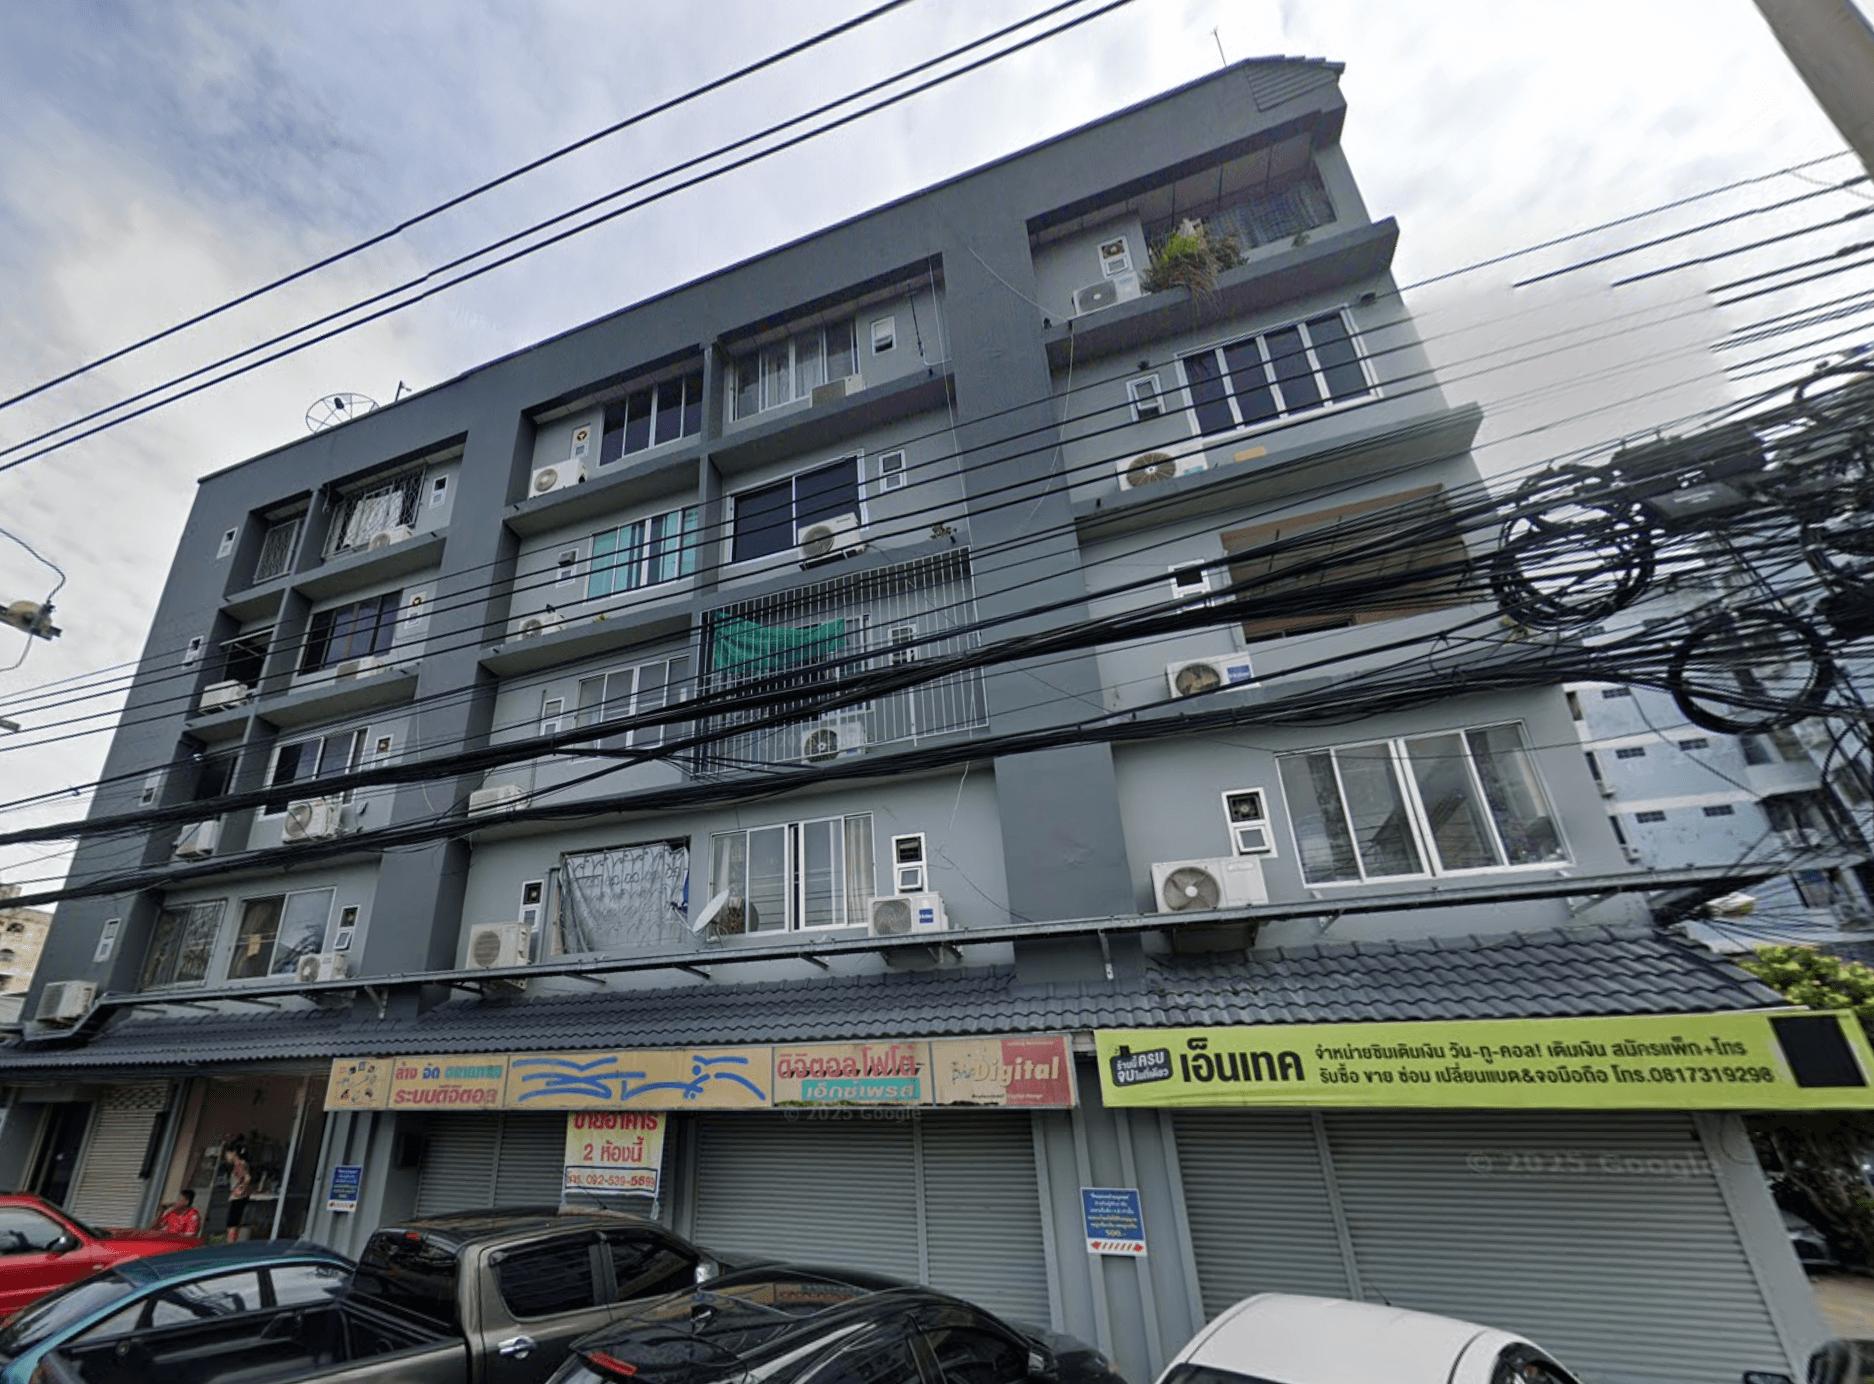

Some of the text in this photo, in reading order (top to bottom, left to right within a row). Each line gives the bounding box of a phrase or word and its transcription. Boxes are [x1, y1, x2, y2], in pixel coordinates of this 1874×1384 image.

[777, 1053, 858, 1079] ดิจิตอล
[1180, 1037, 1305, 1083] เอ็นเทค
[1449, 1042, 1543, 1065] วัน-ทู-คอล!
[974, 1056, 1059, 1087] Digital
[1319, 1063, 1360, 1083] รับซื้อ
[1363, 1070, 1394, 1084] ขาย
[1398, 1066, 1432, 1083] ซ่อม
[583, 1136, 644, 1163] 2 ห้องนี้
